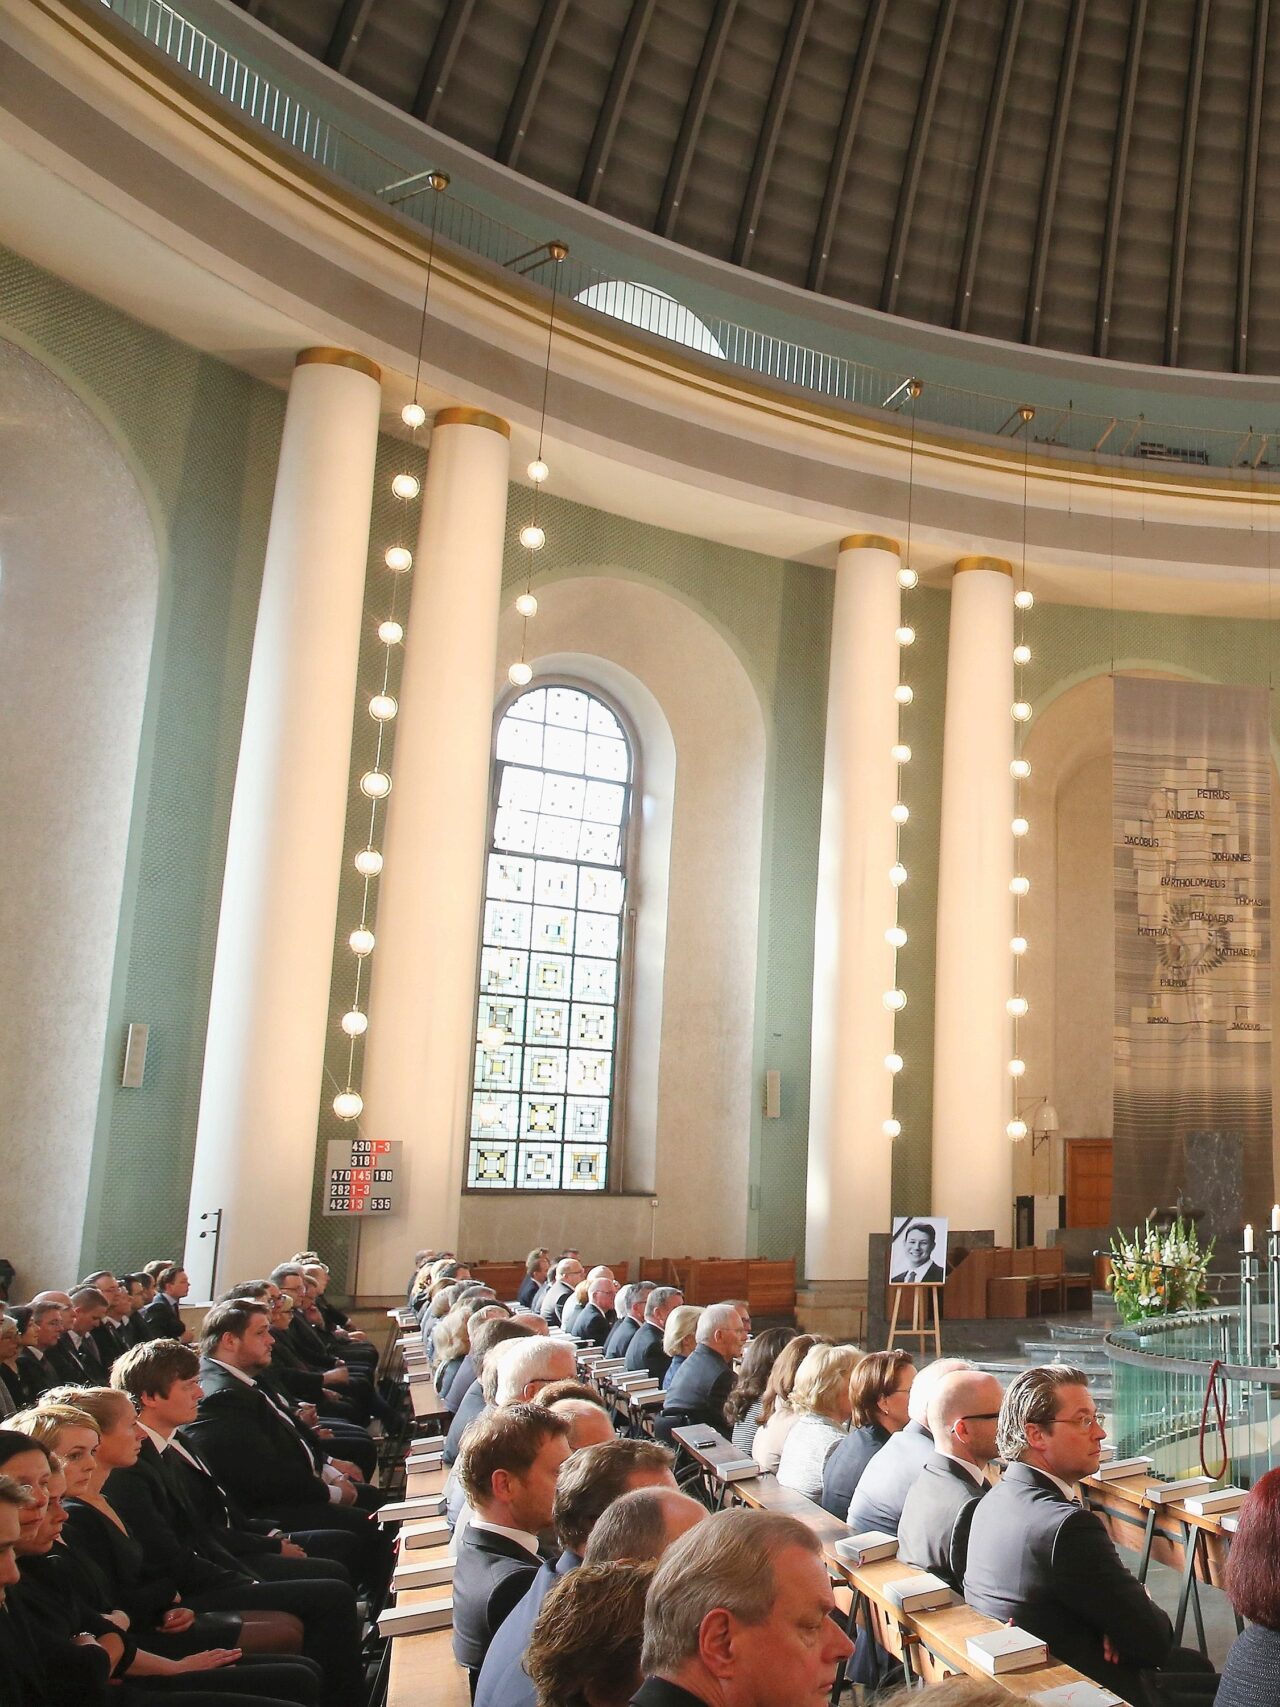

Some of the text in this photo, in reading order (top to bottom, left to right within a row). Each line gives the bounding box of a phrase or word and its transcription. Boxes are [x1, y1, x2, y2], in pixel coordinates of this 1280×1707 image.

[1197, 789, 1230, 800] PETRUS
[1165, 810, 1205, 820] ANDREAS
[1124, 836, 1159, 847] JACOBUS
[1212, 853, 1251, 862] JOHANNES
[1161, 877, 1226, 888] BARTHOLOMAEUS
[1147, 1016, 1169, 1024] SIMON
[374, 1170, 393, 1181] 198
[371, 1198, 391, 1209] 535
